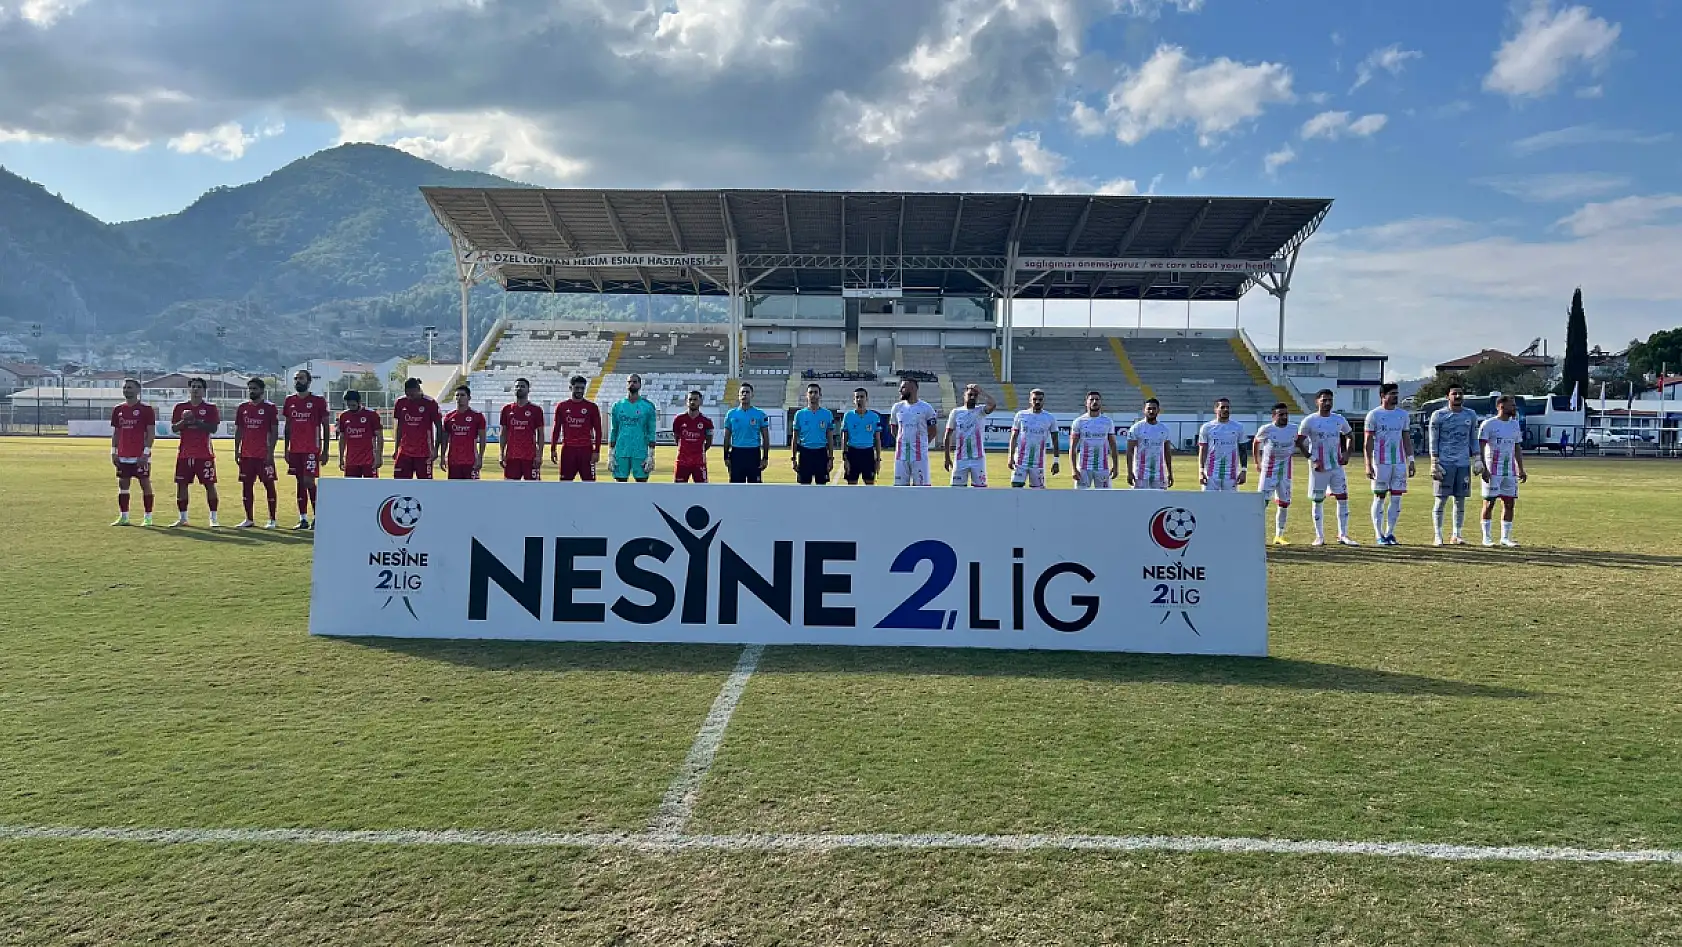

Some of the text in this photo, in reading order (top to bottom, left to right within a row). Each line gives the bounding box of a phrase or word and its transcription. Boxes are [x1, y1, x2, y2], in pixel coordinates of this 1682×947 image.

[611, 256, 644, 265] ESNAF
[1190, 260, 1218, 269] about
[1220, 262, 1242, 271] your
